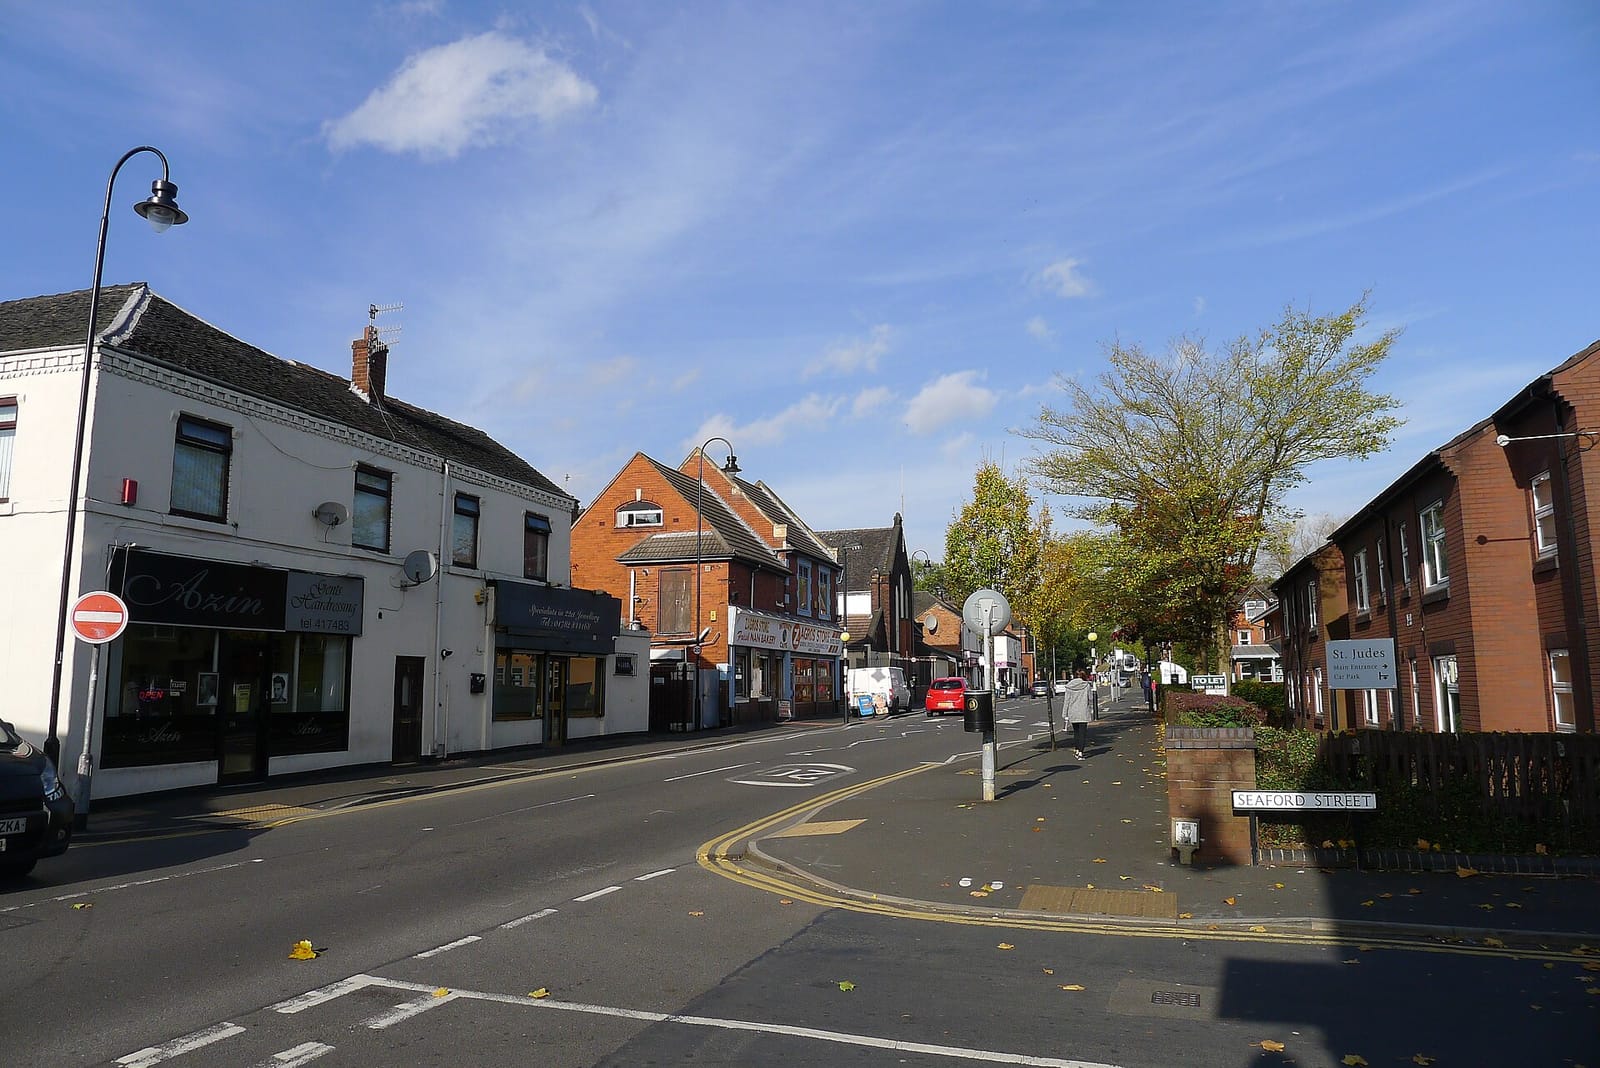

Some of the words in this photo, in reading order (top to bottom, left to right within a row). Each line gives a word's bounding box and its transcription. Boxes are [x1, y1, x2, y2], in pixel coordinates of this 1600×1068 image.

[125, 569, 264, 616] Azin
[310, 580, 344, 599] Gents
[290, 593, 357, 617] Hairdressing
[300, 616, 312, 629] tel
[313, 618, 350, 631] 417483
[1333, 649, 1348, 659] St.
[1352, 647, 1385, 659] Judes
[1194, 677, 1207, 685] TO
[1208, 677, 1225, 685] LET
[1346, 672, 1360, 680] Park
[139, 690, 164, 700] OPEN
[1237, 794, 1305, 808] SEAFORD
[1314, 793, 1372, 808] STREET
